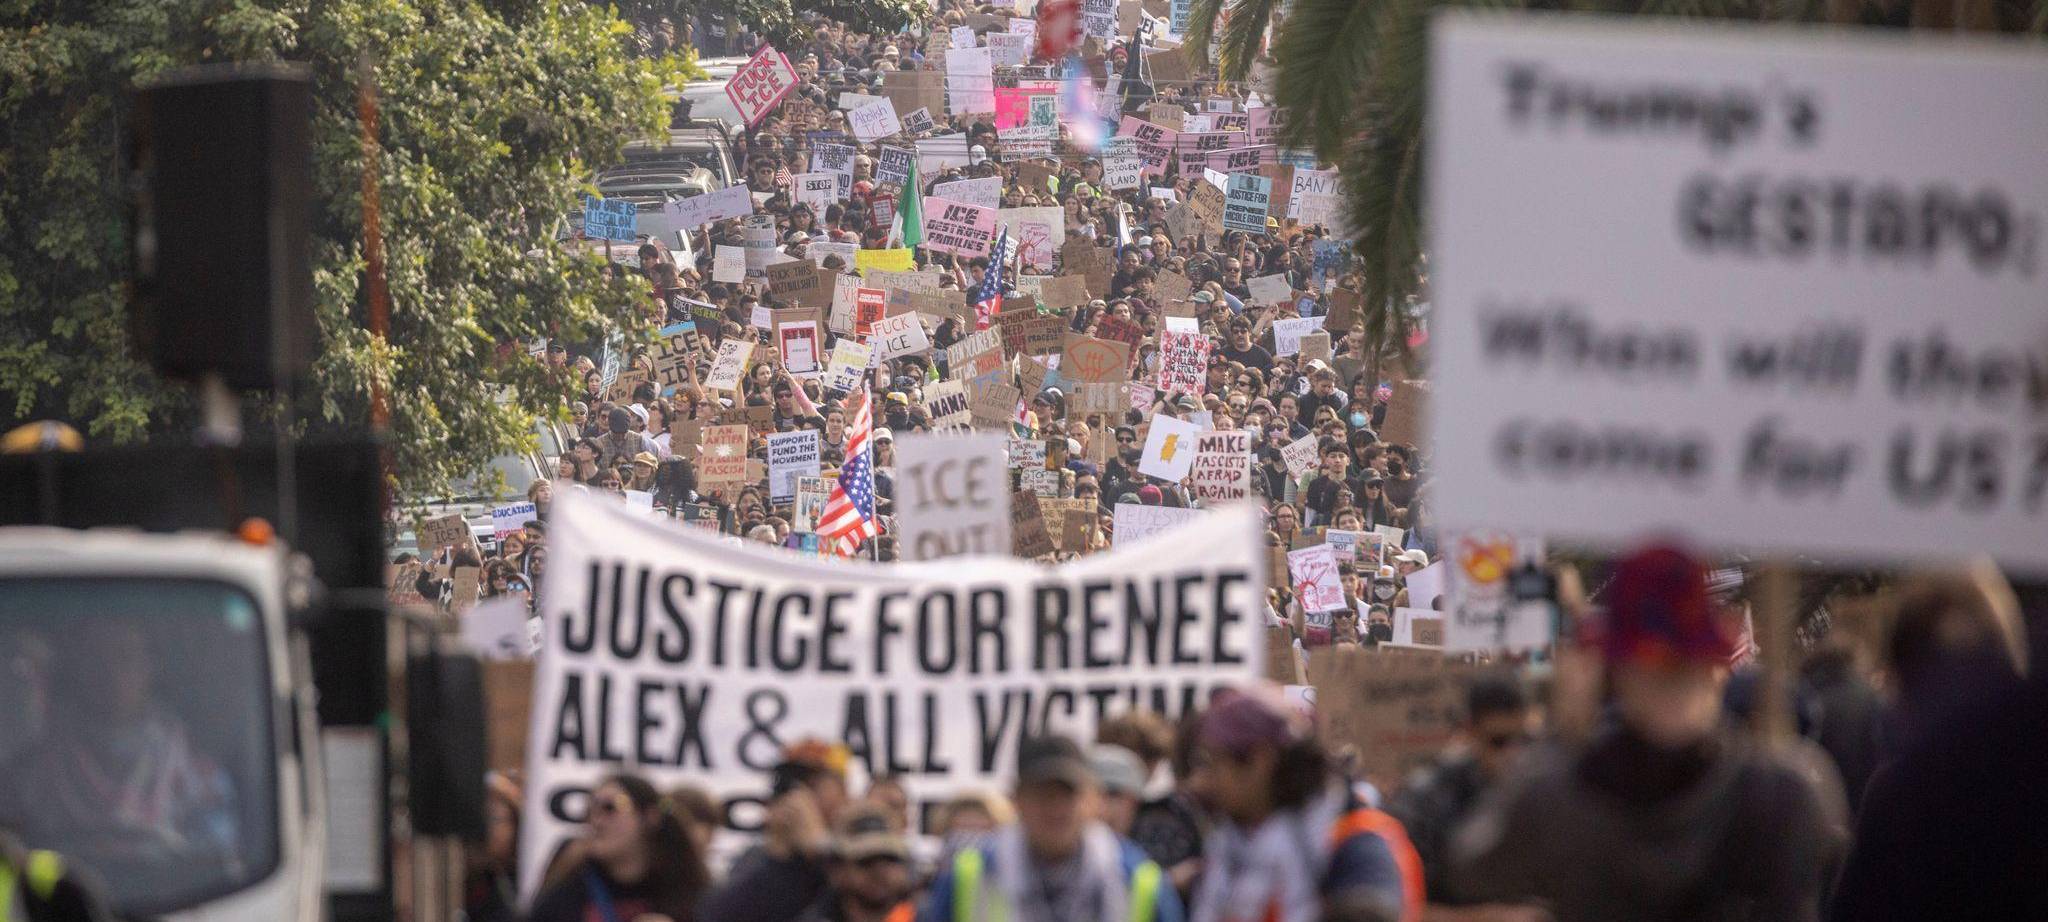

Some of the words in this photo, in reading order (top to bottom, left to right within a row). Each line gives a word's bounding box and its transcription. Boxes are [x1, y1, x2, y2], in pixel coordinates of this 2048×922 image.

[733, 52, 776, 101] FUCK
[745, 72, 784, 115] ICE
[1502, 58, 1818, 152] Trump's
[1135, 124, 1163, 143] ICE
[1197, 135, 1229, 150] ICE
[883, 149, 914, 163] DEFEN
[1228, 150, 1260, 168] ICE
[1107, 164, 1137, 174] STOLEN
[806, 180, 831, 190] STOP
[1111, 175, 1136, 186] LAND
[1295, 176, 1326, 193] BAN
[1227, 188, 1254, 203] JUSTICE
[1255, 192, 1268, 204] FOR
[943, 204, 979, 226] ICE
[1248, 214, 1265, 226] GOOD
[927, 219, 989, 241] DESTROYS
[873, 316, 910, 336] FUCK
[653, 331, 699, 360] ICE
[886, 335, 912, 353] ICE
[1480, 300, 1699, 378] When
[1727, 318, 1865, 392] will
[834, 375, 854, 387] ICE
[1169, 375, 1196, 385] LAND
[770, 435, 808, 447] SUPPORT
[810, 433, 816, 442] &
[1199, 435, 1245, 453] MAKE
[772, 446, 797, 456] FUND
[799, 443, 816, 453] THE
[1494, 415, 1713, 483] come
[1741, 414, 1856, 493] for
[772, 453, 817, 466] MOVEMENT
[1196, 456, 1246, 469] FASCISTS
[904, 456, 992, 513] ICE
[1198, 485, 1244, 499] AGAIN
[492, 504, 535, 518] EDUCATION
[559, 563, 858, 675] JUSTICE
[873, 586, 1005, 676] FOR
[1032, 572, 1250, 672] RENEE
[549, 674, 716, 770] ALEX
[735, 688, 790, 772] &
[843, 689, 951, 776] ALL
